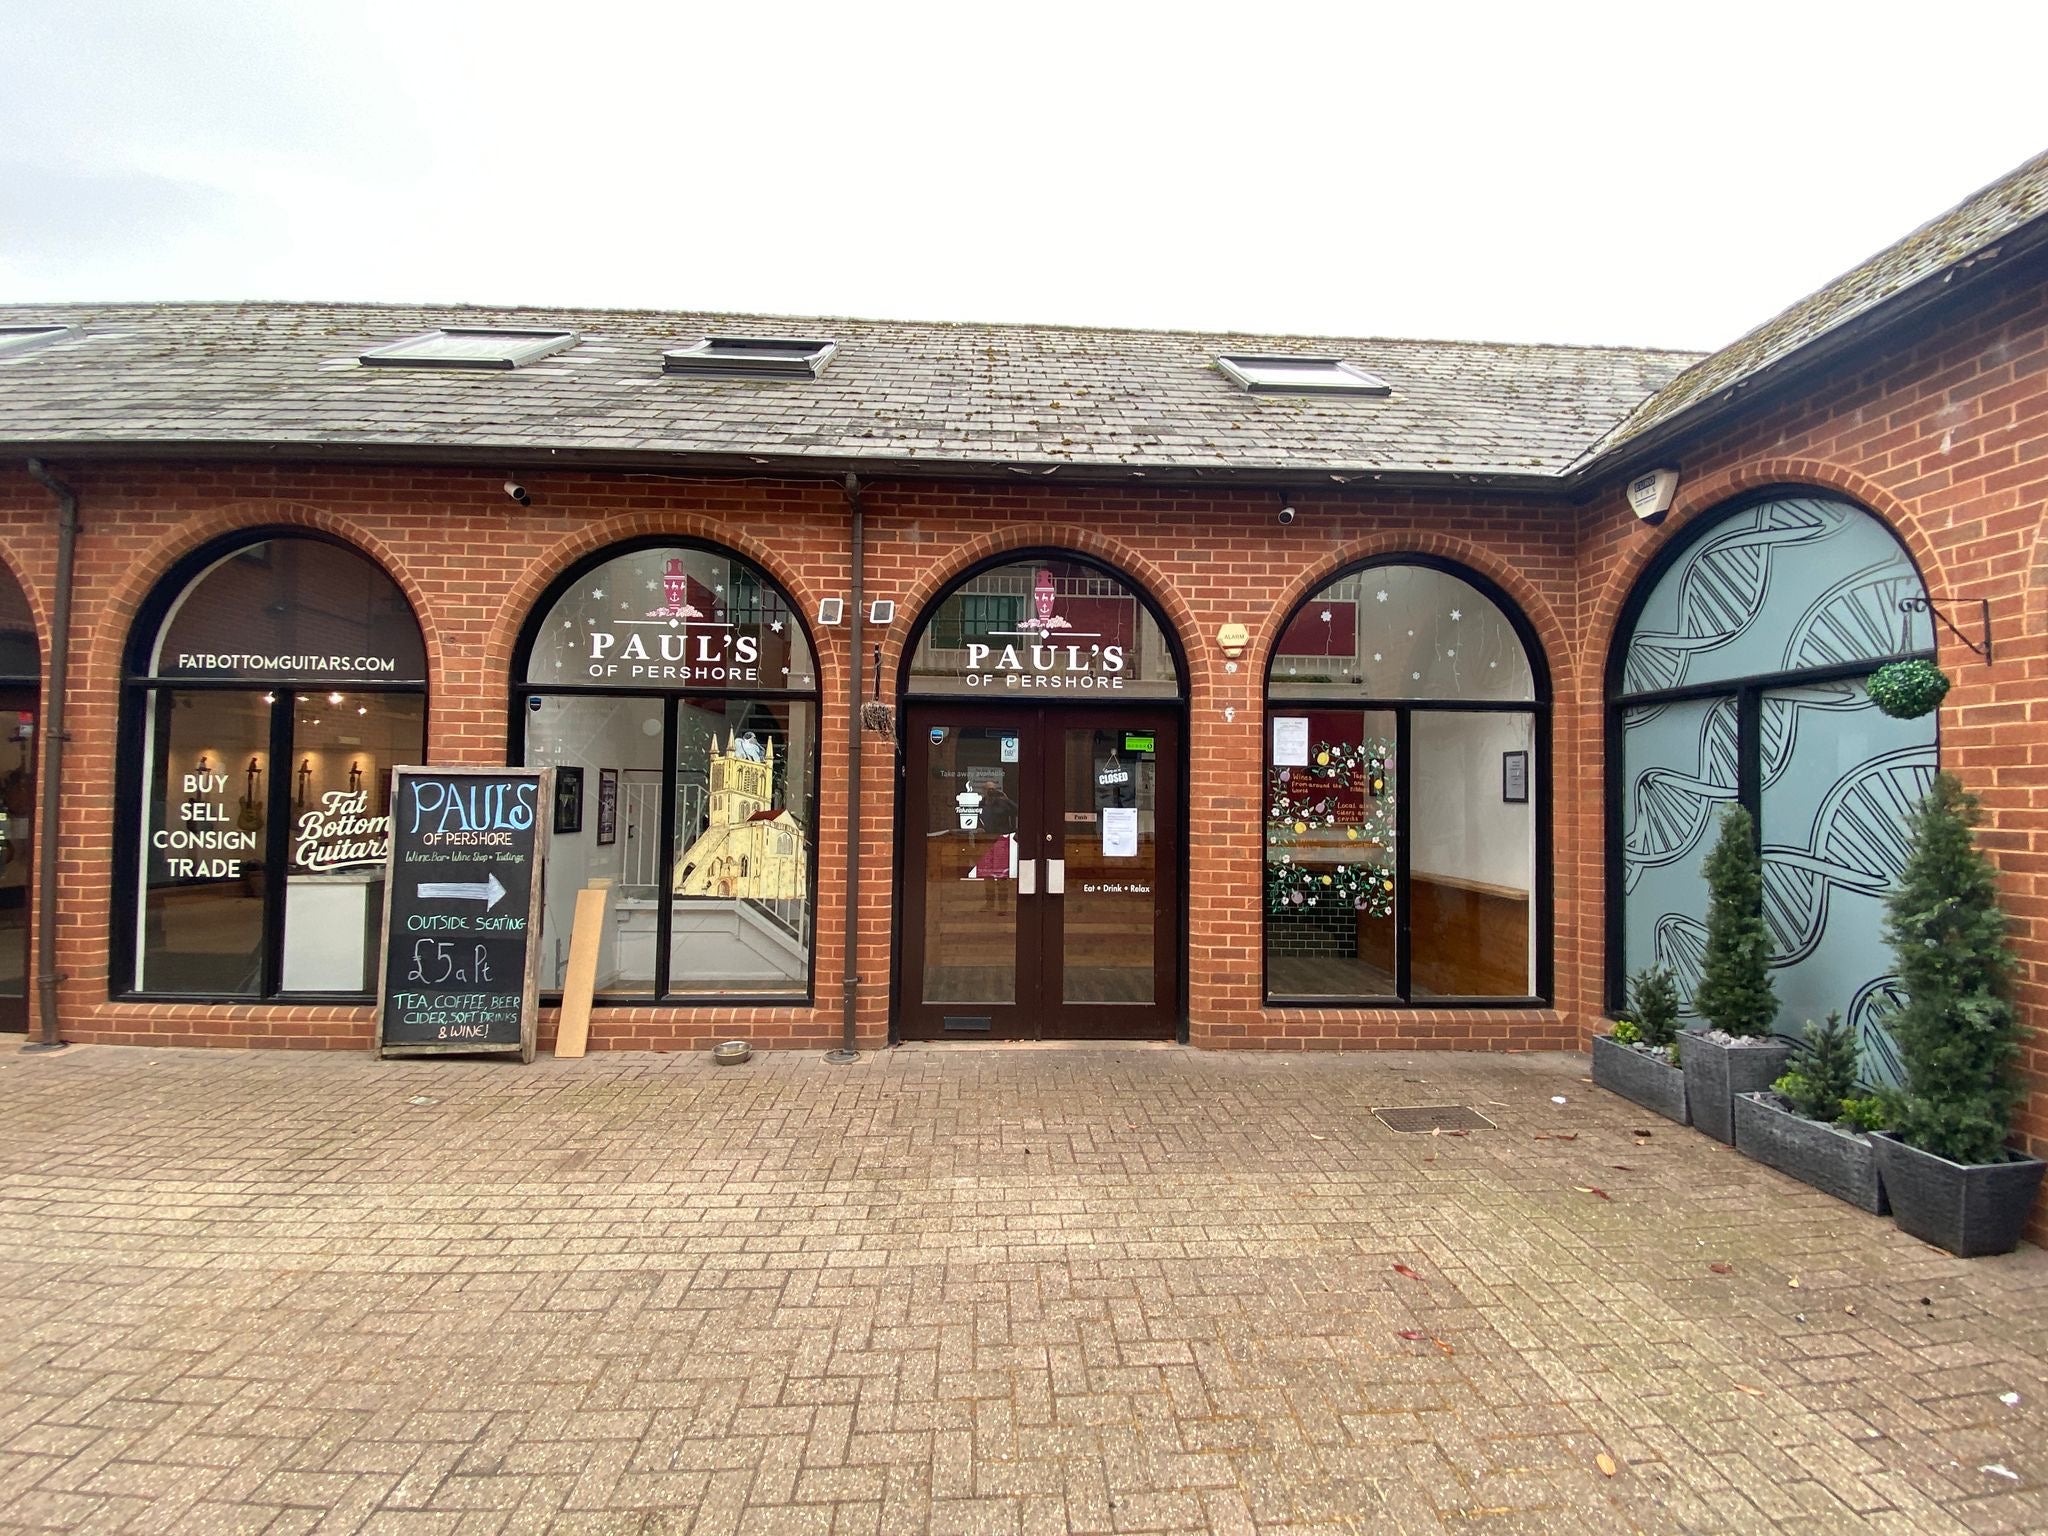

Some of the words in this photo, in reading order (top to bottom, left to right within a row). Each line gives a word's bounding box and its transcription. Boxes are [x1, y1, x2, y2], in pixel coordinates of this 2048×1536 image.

[590, 633, 758, 664] PAUL'S
[179, 654, 394, 672] FATBOTTOMGUITARS.COM
[966, 644, 1124, 672] PAUL'S
[589, 664, 617, 677] OF
[632, 665, 758, 681] PERSHORE
[966, 674, 992, 686] OF
[1006, 674, 1123, 689] PERSHORE
[184, 775, 228, 793] BUY
[1099, 772, 1128, 784] CLOSED
[322, 790, 367, 816] Fat
[180, 803, 230, 822] SELL
[296, 811, 389, 842] Bottom
[154, 831, 256, 850] CONSIGN
[424, 832, 442, 846] OF
[446, 832, 512, 846] PERSHORE
[296, 835, 389, 869] Guitars
[406, 851, 430, 862] Wine
[432, 851, 447, 862] Bar
[452, 851, 472, 862] Wine
[472, 851, 488, 862] Shop
[168, 858, 240, 878] TRADE
[1084, 884, 1096, 892] Eat
[1104, 884, 1122, 893] Drink
[1130, 884, 1150, 893] Relax
[408, 914, 470, 930] OUTSIDE
[408, 938, 454, 984] £5
[491, 996, 520, 1010] BEER
[450, 1010, 479, 1023] SOFT
[480, 1010, 517, 1024] DRINKS
[438, 1026, 446, 1038] &
[450, 1024, 489, 1038] WINE!
